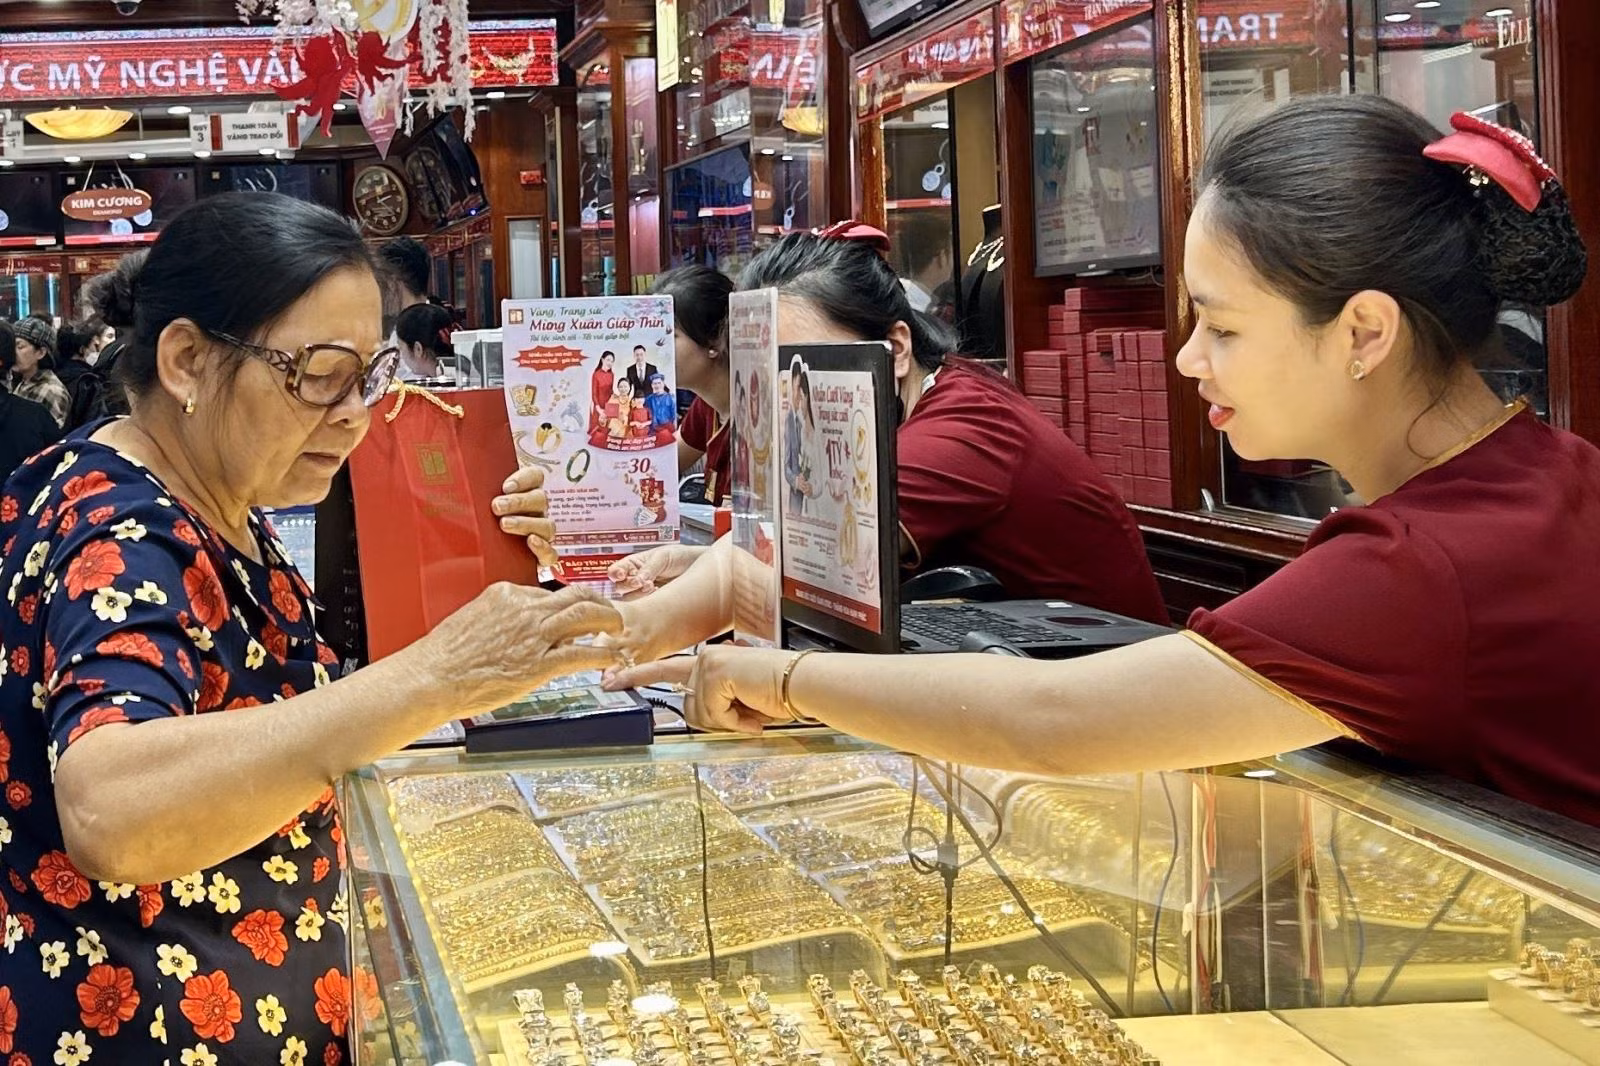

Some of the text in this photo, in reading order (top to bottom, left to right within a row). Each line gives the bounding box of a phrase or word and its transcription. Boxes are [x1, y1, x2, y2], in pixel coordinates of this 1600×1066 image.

[48, 55, 106, 90] MỸ
[119, 51, 229, 93] NGHỆ
[197, 132, 205, 143] 3
[71, 195, 143, 209] KIM CƯƠNG
[560, 306, 587, 317] Trang
[569, 318, 603, 331] Xuân
[606, 316, 636, 332] Giáp
[639, 316, 665, 329] Thìn
